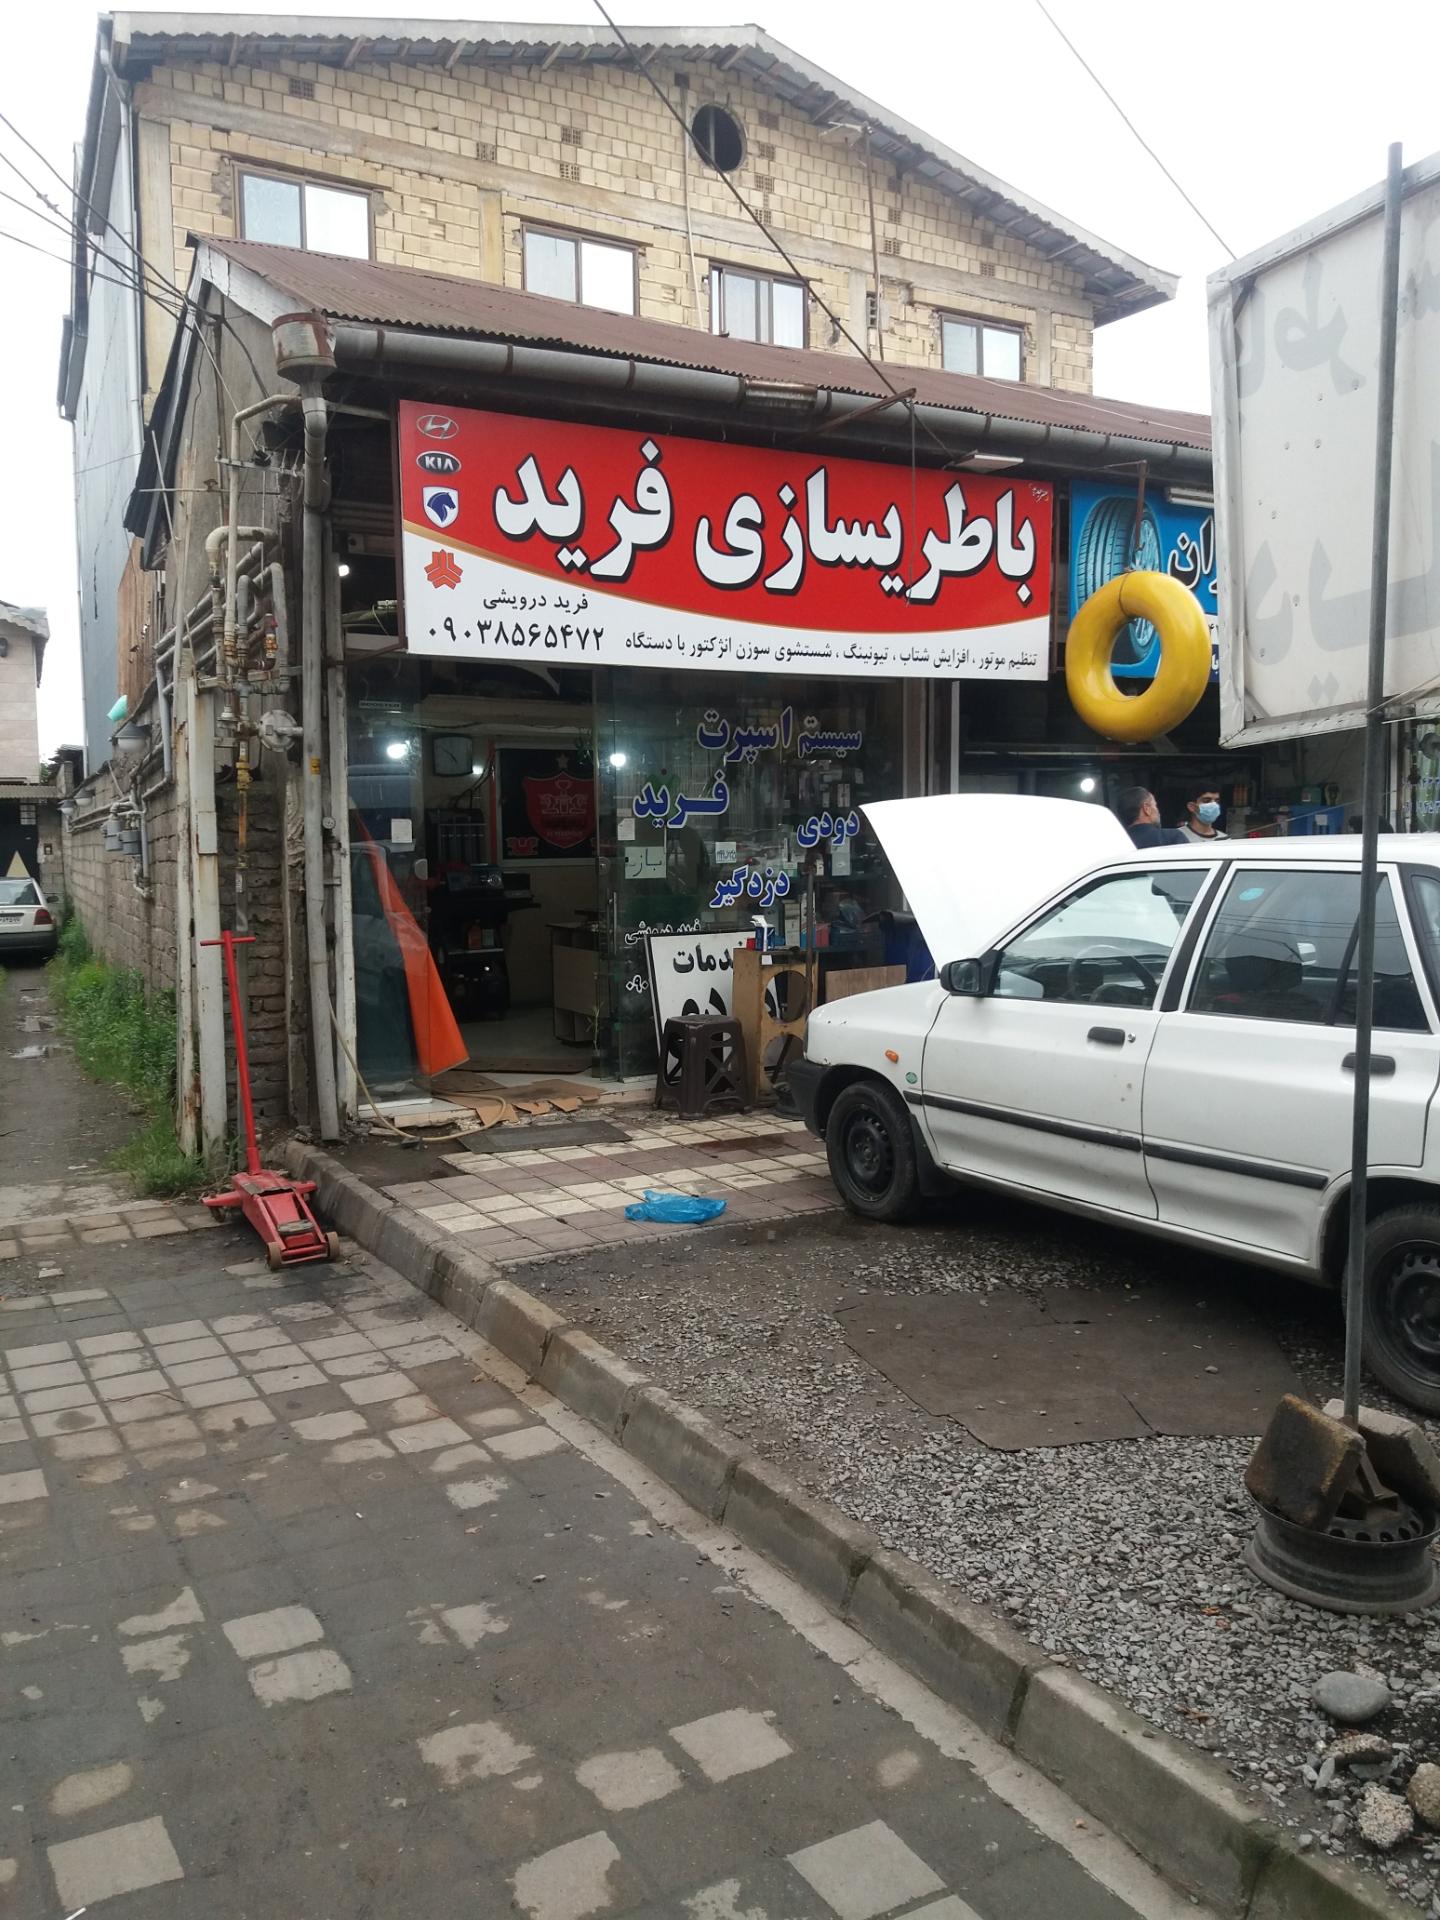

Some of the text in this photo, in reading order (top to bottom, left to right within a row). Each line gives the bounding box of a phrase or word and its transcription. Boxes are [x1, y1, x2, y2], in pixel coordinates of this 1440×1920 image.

[425, 456, 454, 471] KIA
[493, 437, 675, 583] فرید
[483, 589, 589, 614] فرید درویشی
[429, 616, 604, 651] ۰۹۰۳۸۵۶۵۴۷۲
[625, 631, 672, 650] دستگاه
[677, 633, 686, 656] با
[690, 636, 732, 658] انژکتور
[736, 642, 770, 660] سوزن
[774, 642, 833, 662] شستشوی
[933, 648, 970, 668] افزایش
[1008, 652, 1038, 671] تنظیم
[697, 706, 862, 764] سیستم اسپرت
[633, 768, 730, 829] فرید
[797, 811, 860, 848] دودی
[709, 865, 790, 908] دزدگیر
